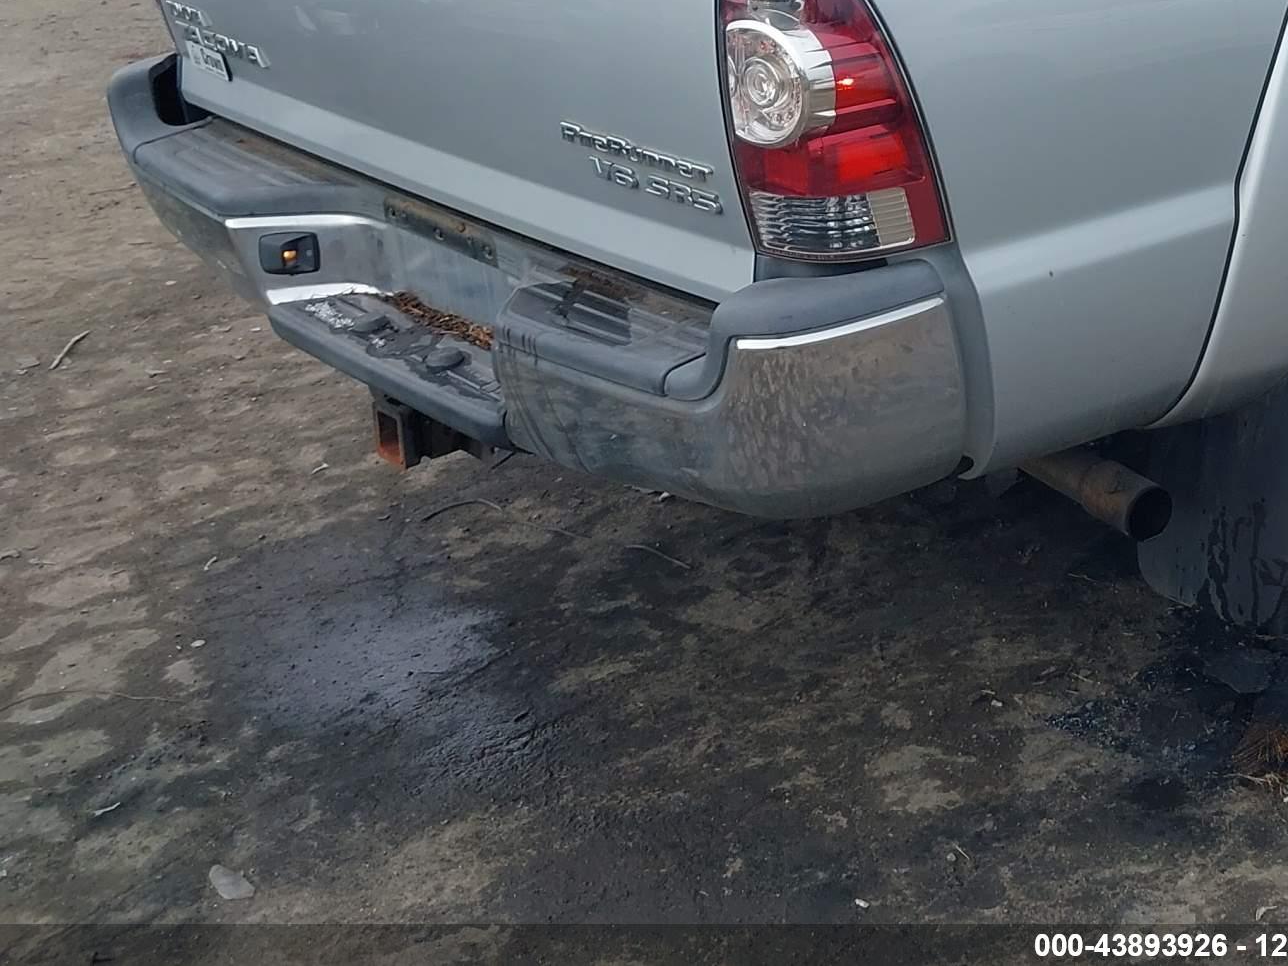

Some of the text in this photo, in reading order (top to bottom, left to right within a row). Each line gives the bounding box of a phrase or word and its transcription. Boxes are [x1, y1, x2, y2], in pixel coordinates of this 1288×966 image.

[175, 20, 271, 68] TACOMA
[559, 121, 715, 182] PreRunner
[589, 155, 724, 215] V6 SR5
